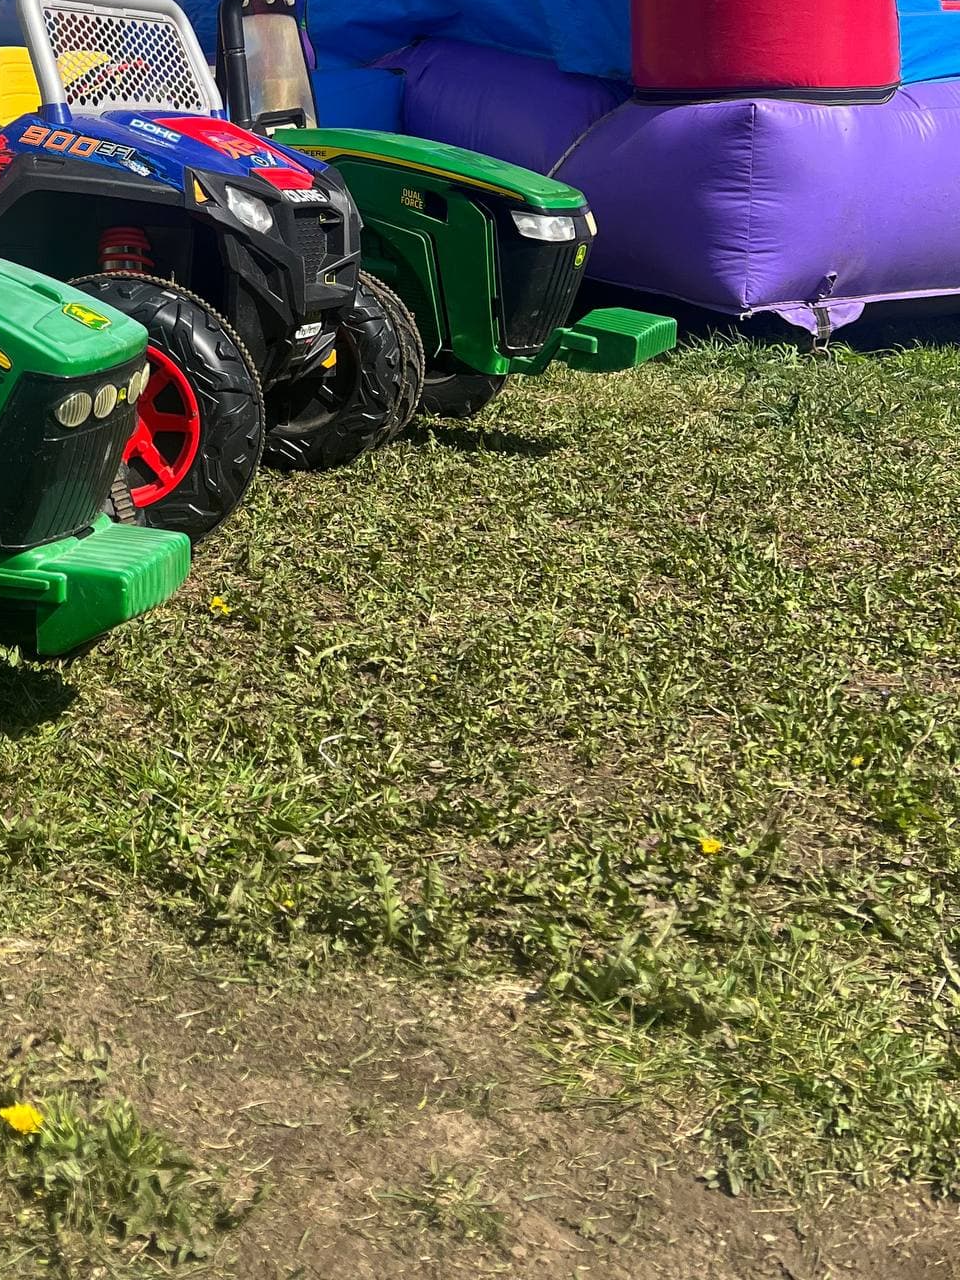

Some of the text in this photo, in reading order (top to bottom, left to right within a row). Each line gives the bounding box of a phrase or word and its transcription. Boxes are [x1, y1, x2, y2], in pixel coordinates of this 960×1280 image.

[129, 118, 183, 144] DOHC
[18, 124, 101, 158] 900
[95, 140, 136, 161] EFI
[400, 196, 424, 210] FORCE
[402, 187, 422, 201] DUAL
